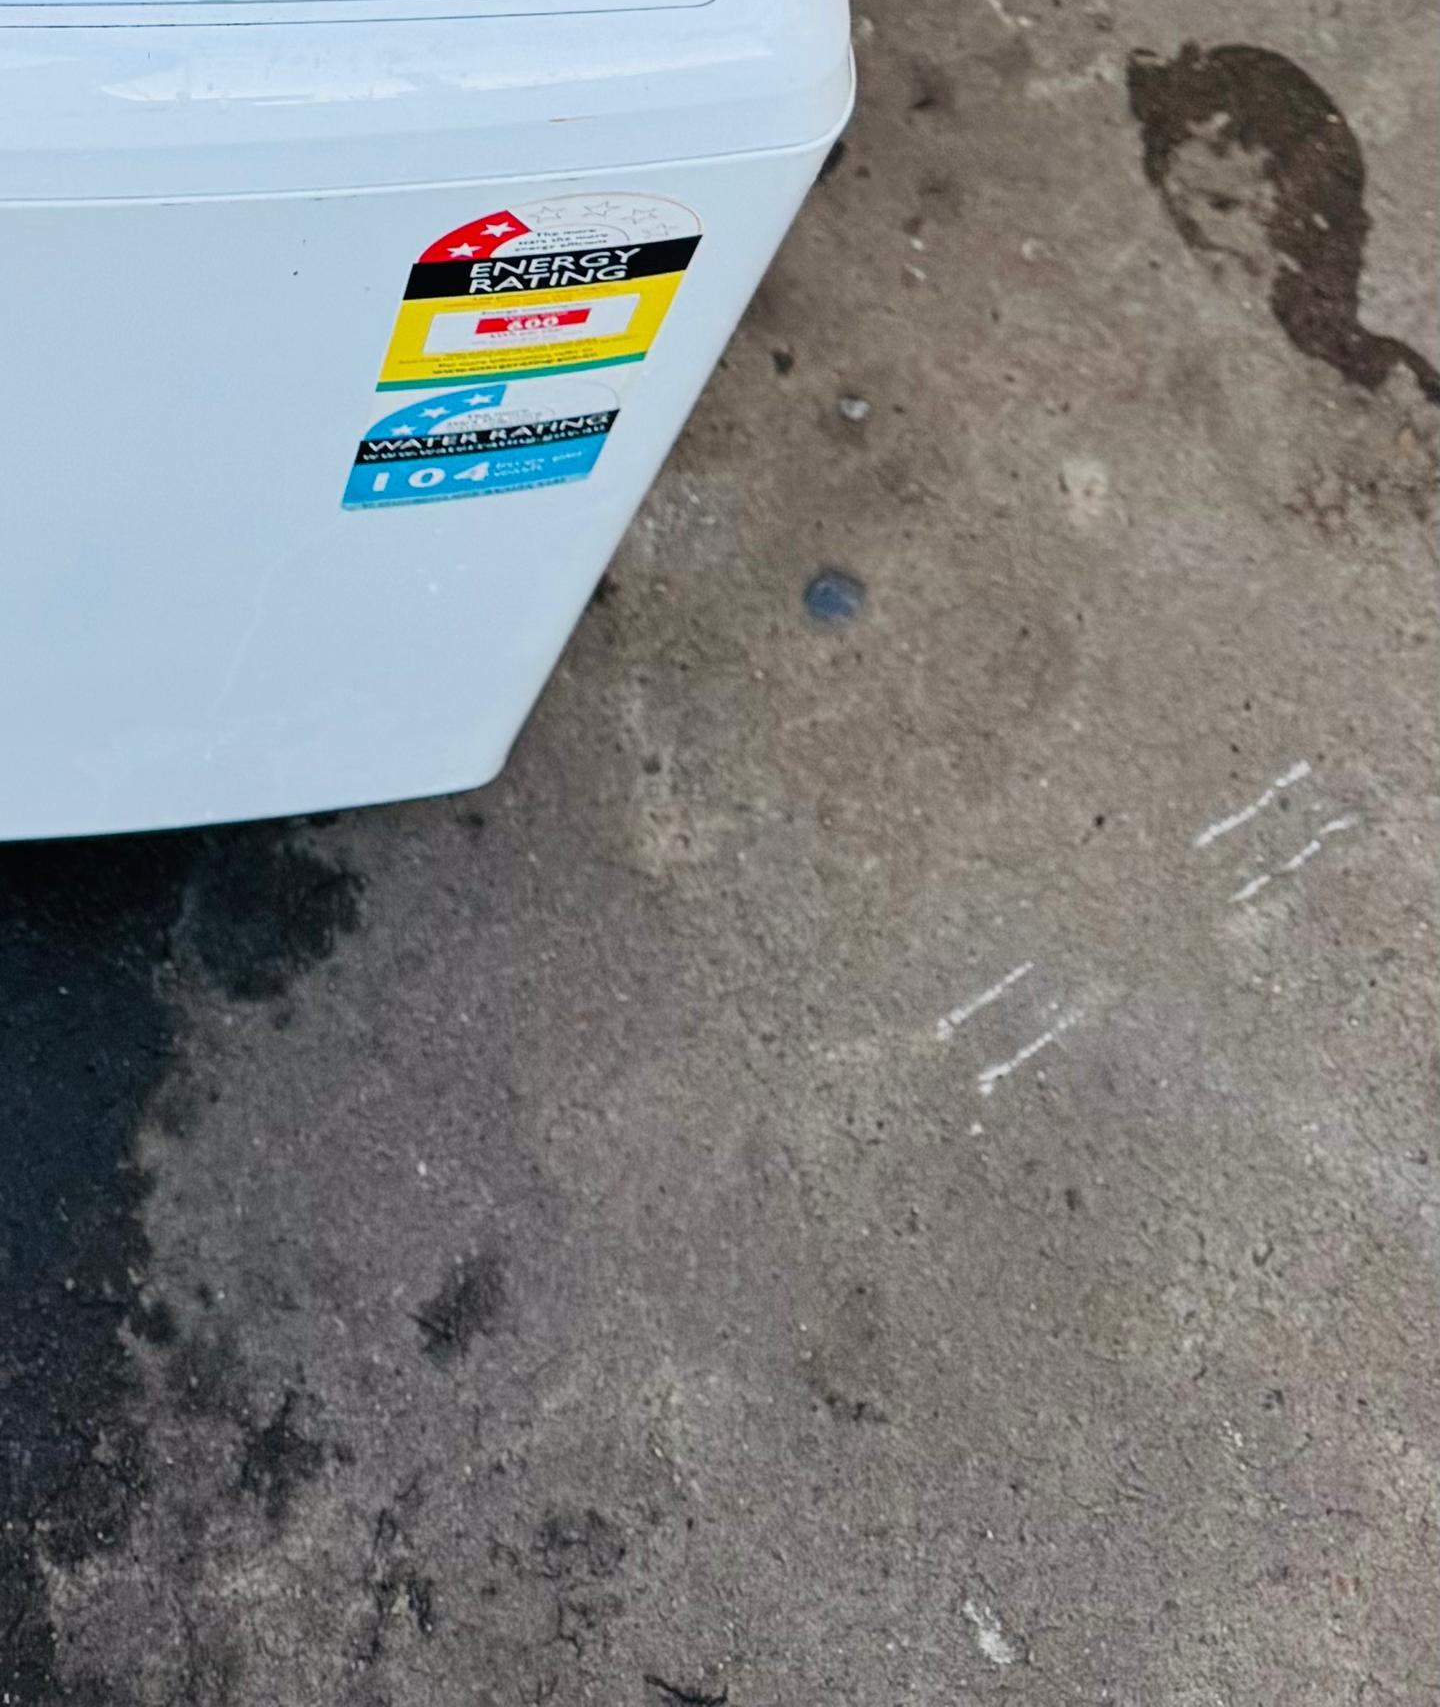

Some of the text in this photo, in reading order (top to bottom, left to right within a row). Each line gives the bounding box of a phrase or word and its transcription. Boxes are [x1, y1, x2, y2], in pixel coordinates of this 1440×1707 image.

[469, 247, 642, 279] ENERGY
[469, 265, 629, 294] RATING
[368, 432, 478, 452] WATER
[488, 415, 610, 441] RATING
